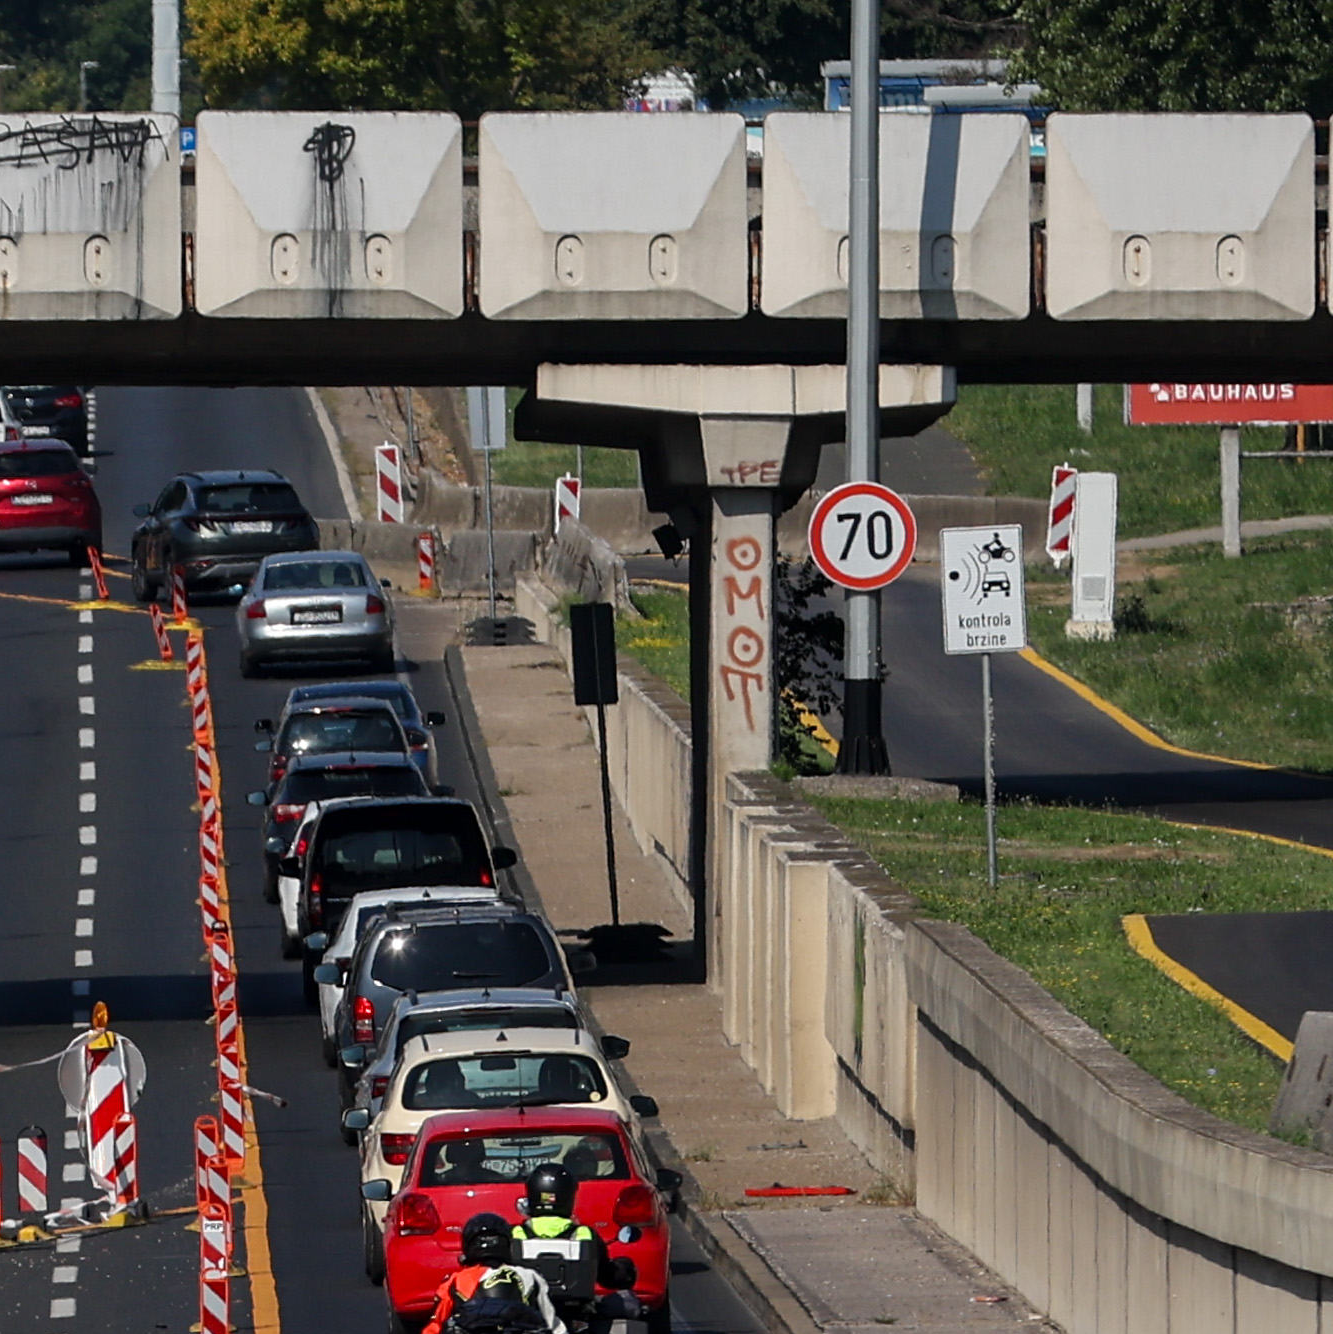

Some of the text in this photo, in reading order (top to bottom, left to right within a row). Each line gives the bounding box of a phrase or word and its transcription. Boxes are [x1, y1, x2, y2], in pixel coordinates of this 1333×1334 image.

[1174, 383, 1295, 400] BAUHAUS
[837, 510, 893, 560] 70
[959, 612, 1011, 629] kontrola
[967, 633, 1007, 647] brzine
